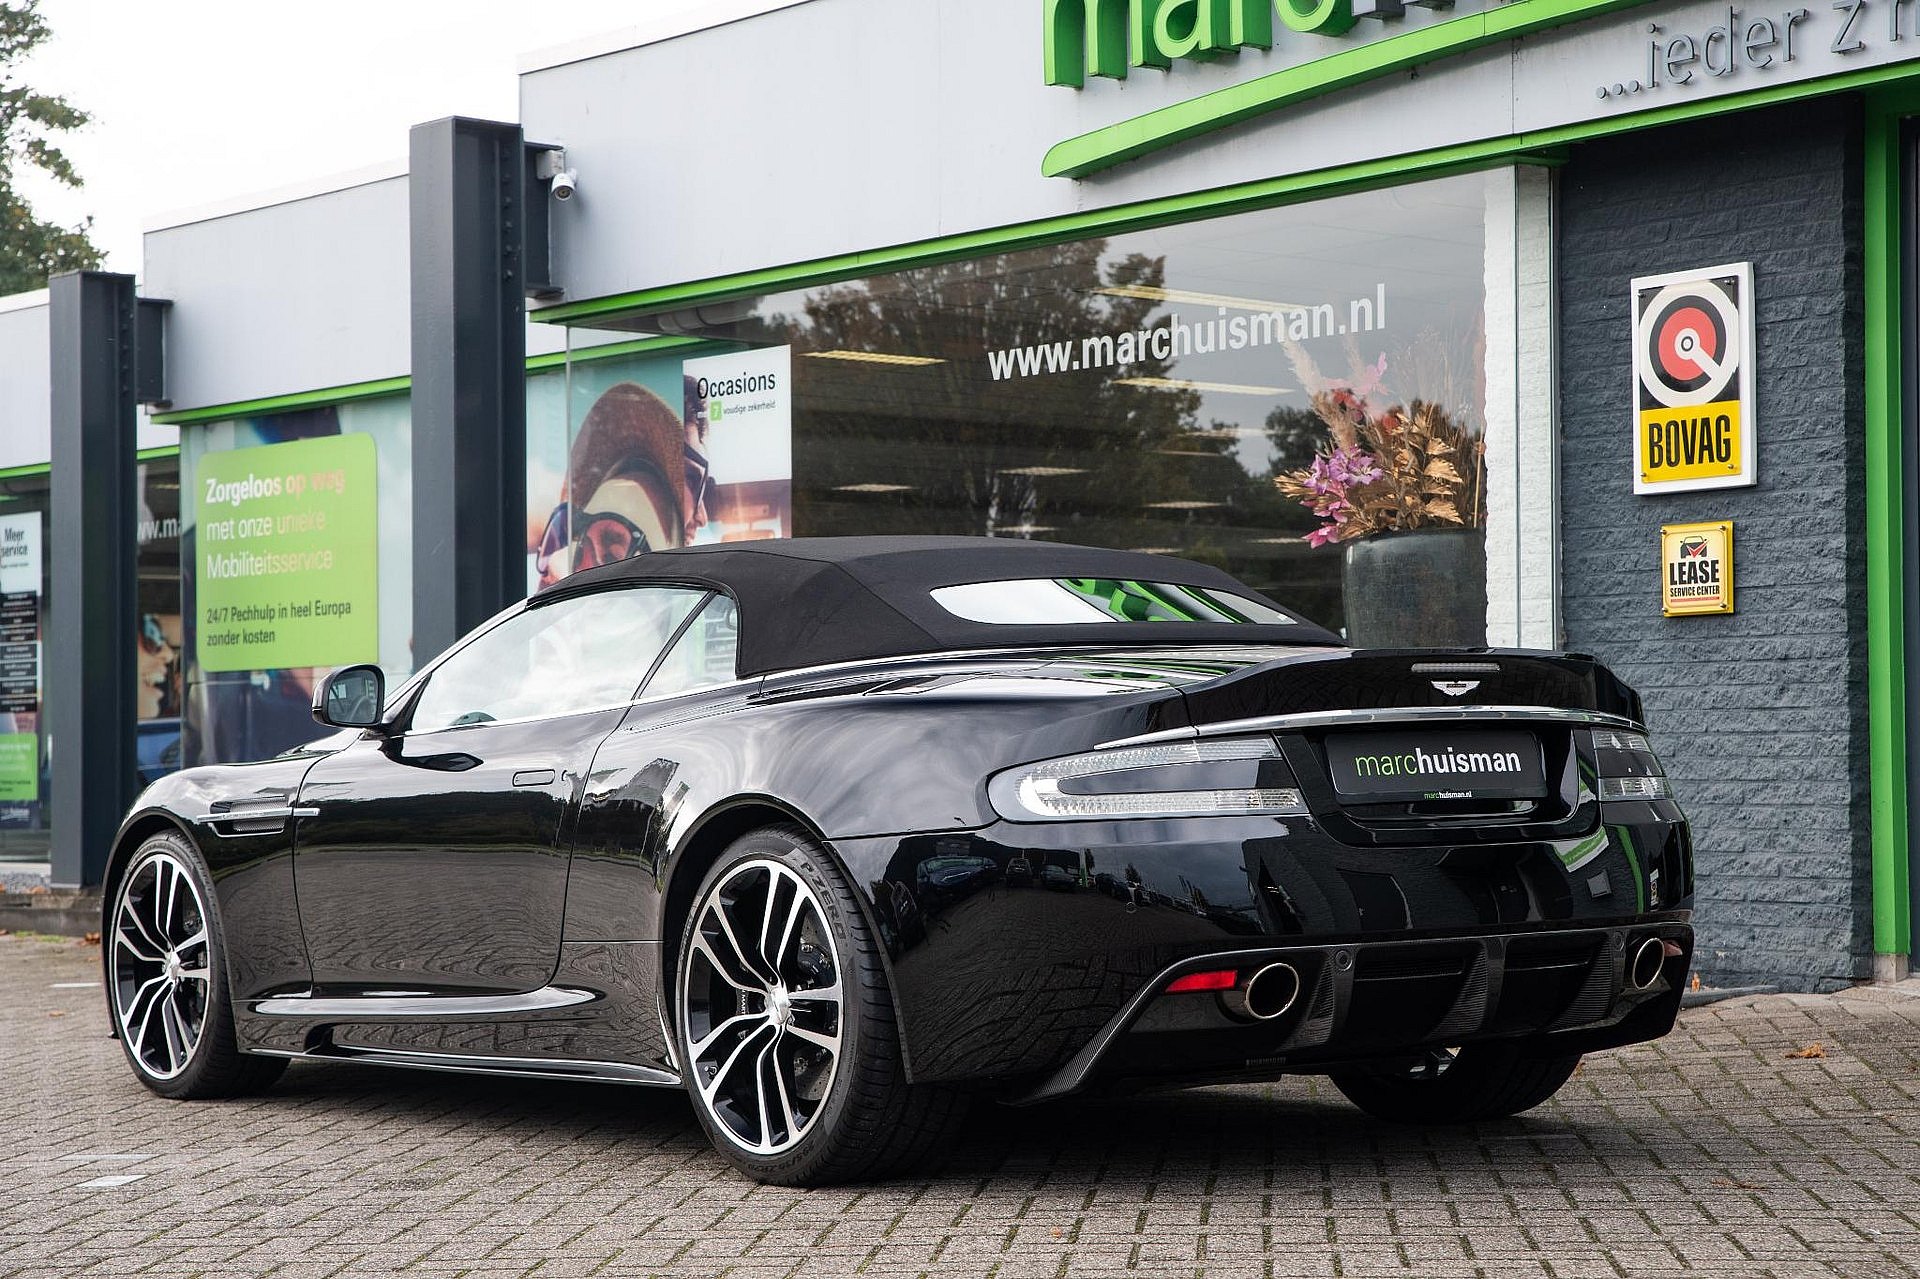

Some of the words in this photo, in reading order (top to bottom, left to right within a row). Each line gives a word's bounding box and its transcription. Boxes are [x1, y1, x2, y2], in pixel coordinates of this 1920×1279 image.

[988, 283, 1385, 381] www.marchuisman.nl
[697, 371, 776, 399] Occasions
[1649, 415, 1732, 469] BOVAG
[205, 473, 282, 507] Zorgeloos
[285, 474, 307, 499] op
[311, 469, 346, 495] weg
[4, 528, 25, 541] Meer
[206, 519, 235, 541] met
[238, 516, 273, 538] onze
[276, 509, 326, 535] unieke
[206, 546, 333, 579] Mobiliteitsservice
[1669, 559, 1720, 586] LEASE
[1670, 586, 1696, 598] SERVICE
[1696, 585, 1720, 596] CENTER
[206, 607, 229, 624] 24/7
[230, 605, 276, 623] Pechhulp
[278, 605, 288, 619] in
[290, 601, 312, 618] heel
[315, 599, 351, 619] Europa
[206, 629, 240, 646] zonder
[242, 628, 276, 645] kosten
[1355, 747, 1522, 777] marchuisman
[1423, 790, 1473, 799] marchuisman.nl
